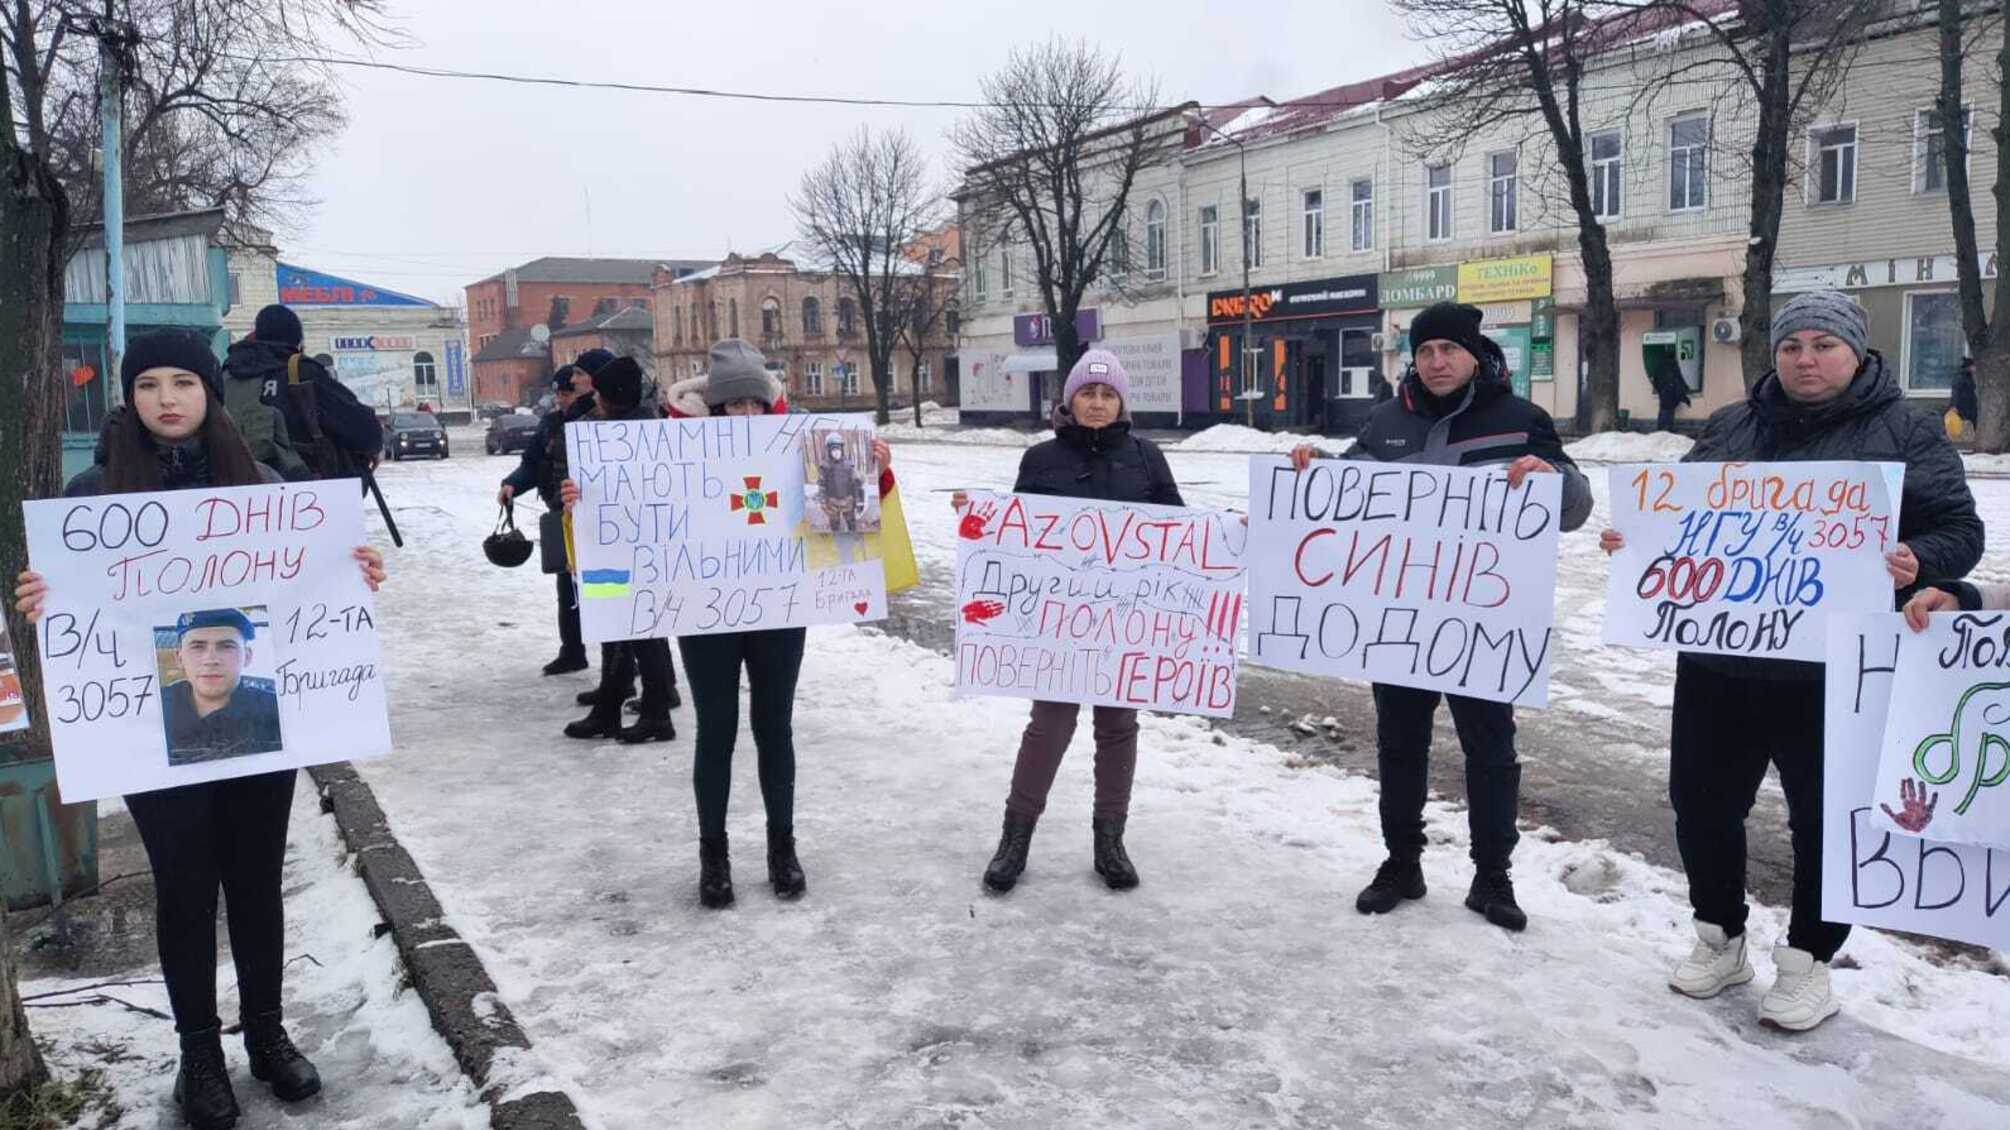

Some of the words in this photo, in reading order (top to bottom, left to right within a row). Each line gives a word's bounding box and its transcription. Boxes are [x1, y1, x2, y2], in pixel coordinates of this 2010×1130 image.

[575, 415, 753, 464] НЕЗЛАМНІ
[578, 462, 723, 503] МАЮТЬ
[1268, 465, 1551, 541] ПОВЕРНІТЬ
[1631, 468, 1684, 513] 12
[62, 500, 169, 552] 600
[196, 487, 326, 543] ДНІВ
[598, 502, 689, 546] БУТИ
[996, 496, 1239, 571] AZOVSTAL
[1664, 511, 1766, 557] НГУ
[1809, 514, 1890, 553] 3057
[632, 537, 806, 585] ВІЛЬНИМИ
[1294, 527, 1511, 608] СИНІВ
[1636, 556, 1725, 604] 600
[1723, 557, 1825, 608] ДНІВ
[696, 582, 802, 632] 3057
[1257, 595, 1552, 703] ДОДОМУ
[57, 674, 155, 723] 3057
[276, 657, 376, 711] Бригада
[958, 642, 1112, 696] ПОВЕРНІТЬ
[1115, 651, 1235, 710] ГЕРОЇВ
